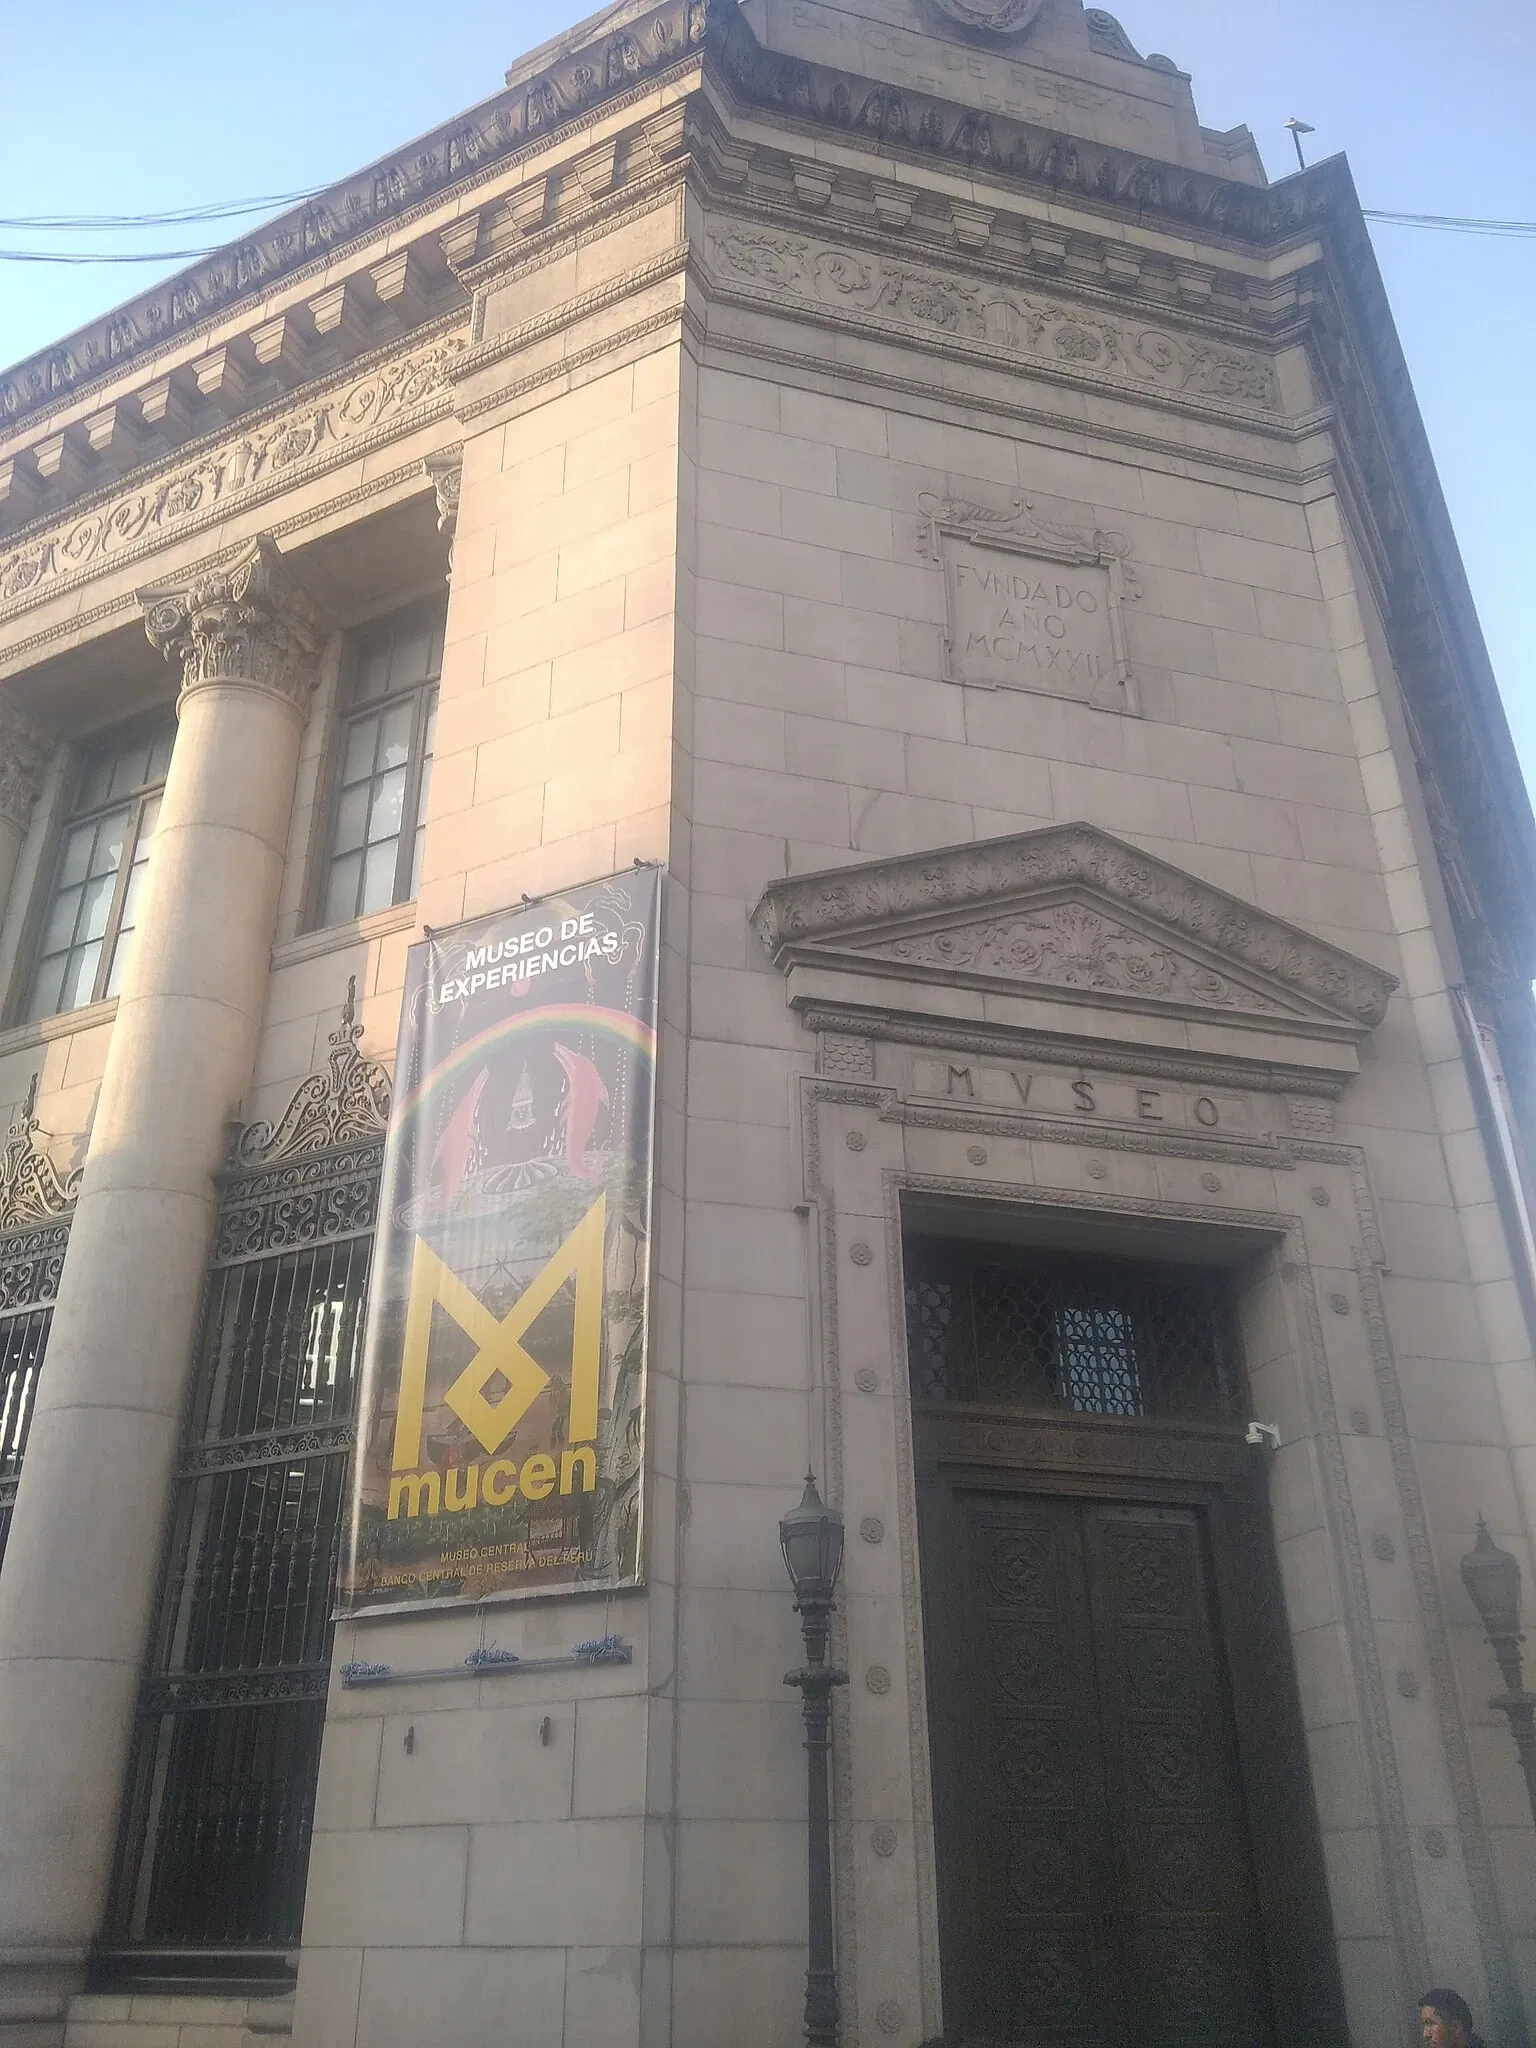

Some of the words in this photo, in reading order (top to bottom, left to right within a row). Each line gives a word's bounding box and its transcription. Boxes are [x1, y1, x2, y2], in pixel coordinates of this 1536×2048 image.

[793, 6, 918, 58] BANCO
[941, 50, 987, 80] DE
[439, 931, 619, 1004] EXPERIENCIAS
[465, 926, 553, 972] MUSEO
[560, 912, 595, 942] DE
[946, 1064, 1219, 1127] MVSEO
[387, 1446, 597, 1521] mucen
[380, 1573, 416, 1586] BANCO
[418, 1566, 466, 1582] CENTRAL
[468, 1565, 484, 1576] DE
[486, 1558, 537, 1574] RESERVA
[538, 1554, 560, 1568] DEL
[440, 1548, 478, 1562] MUSEO
[480, 1542, 530, 1557] CENTRAL
